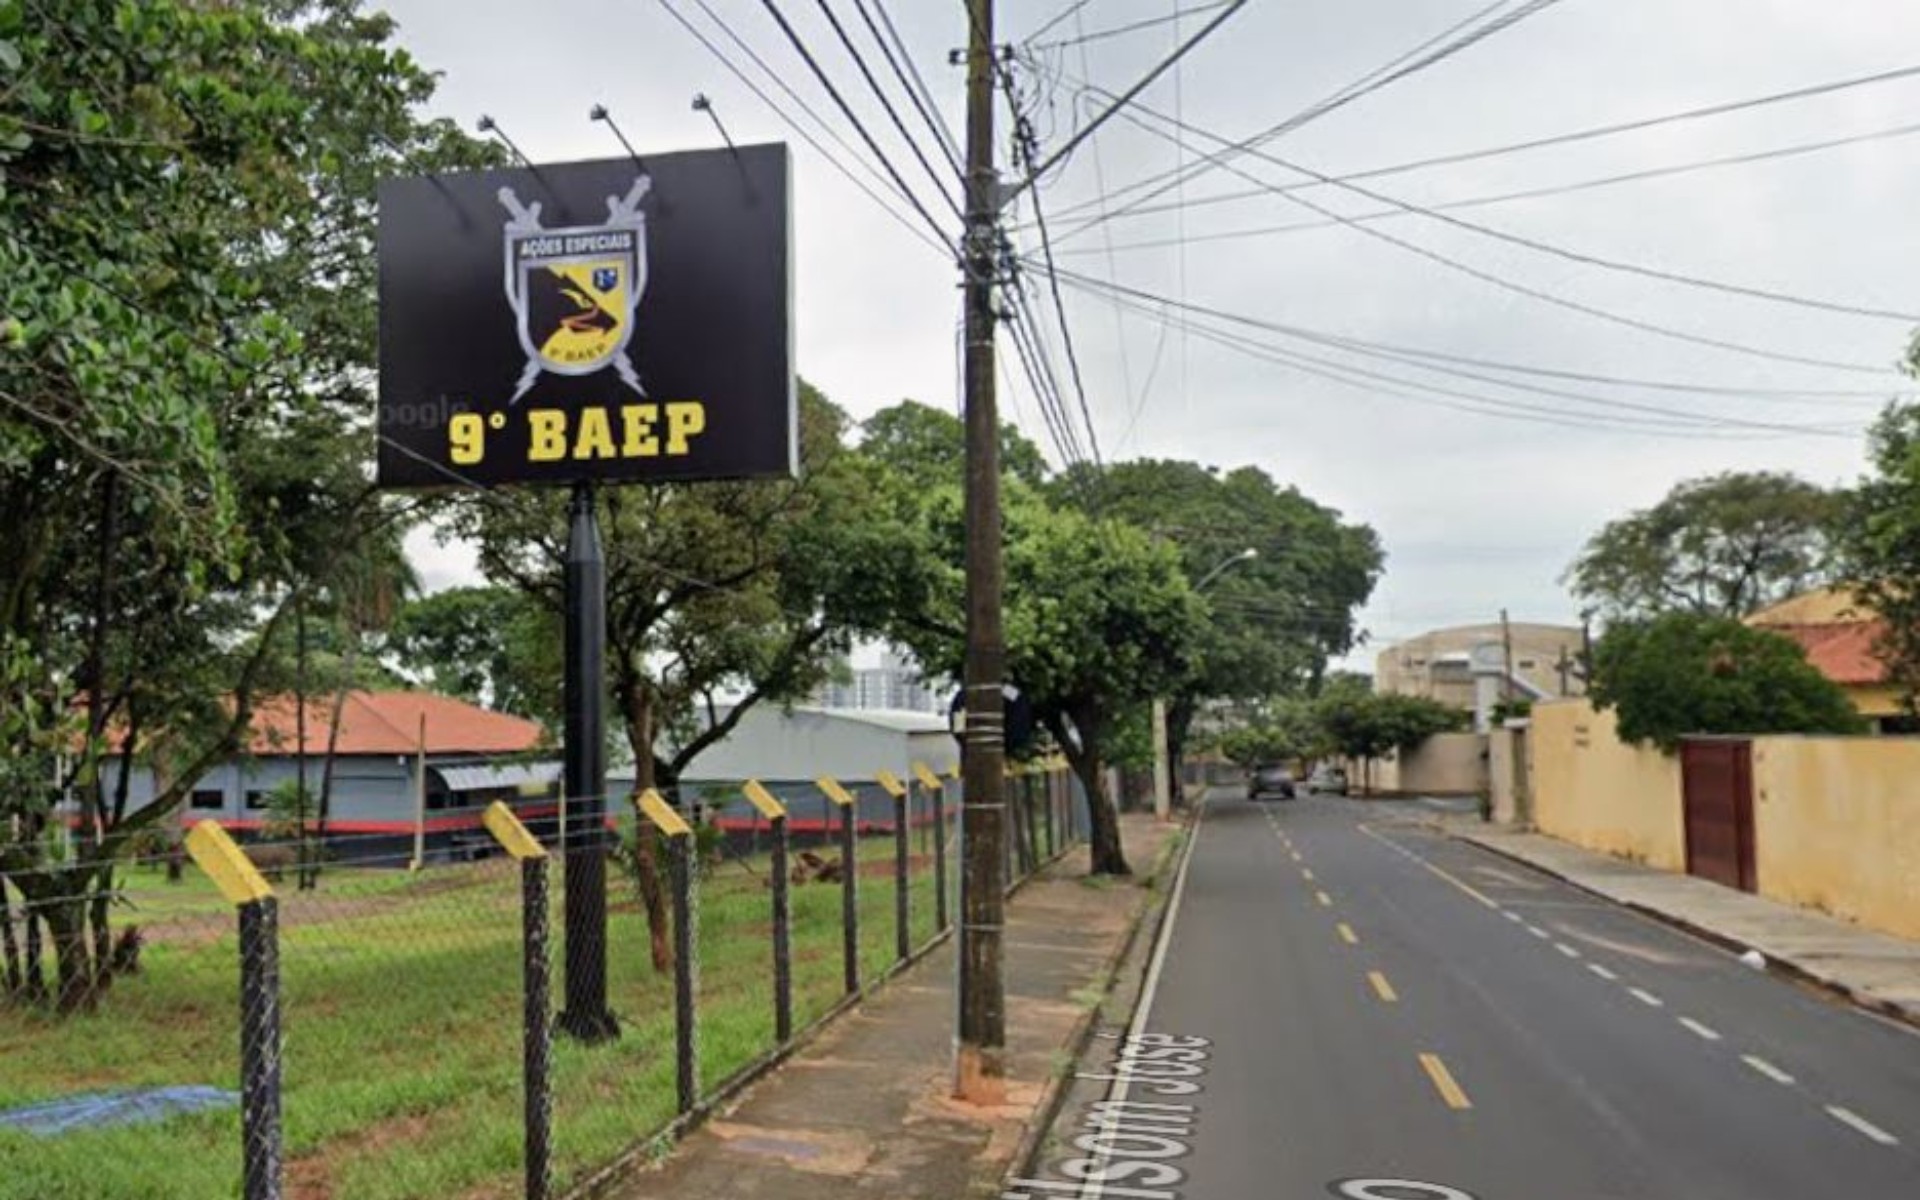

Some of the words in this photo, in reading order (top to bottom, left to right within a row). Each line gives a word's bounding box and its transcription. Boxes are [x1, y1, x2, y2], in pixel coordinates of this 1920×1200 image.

[521, 239, 562, 257] AÇÕES
[566, 233, 631, 252] ESPECIAIS
[528, 402, 706, 460] BAEP
